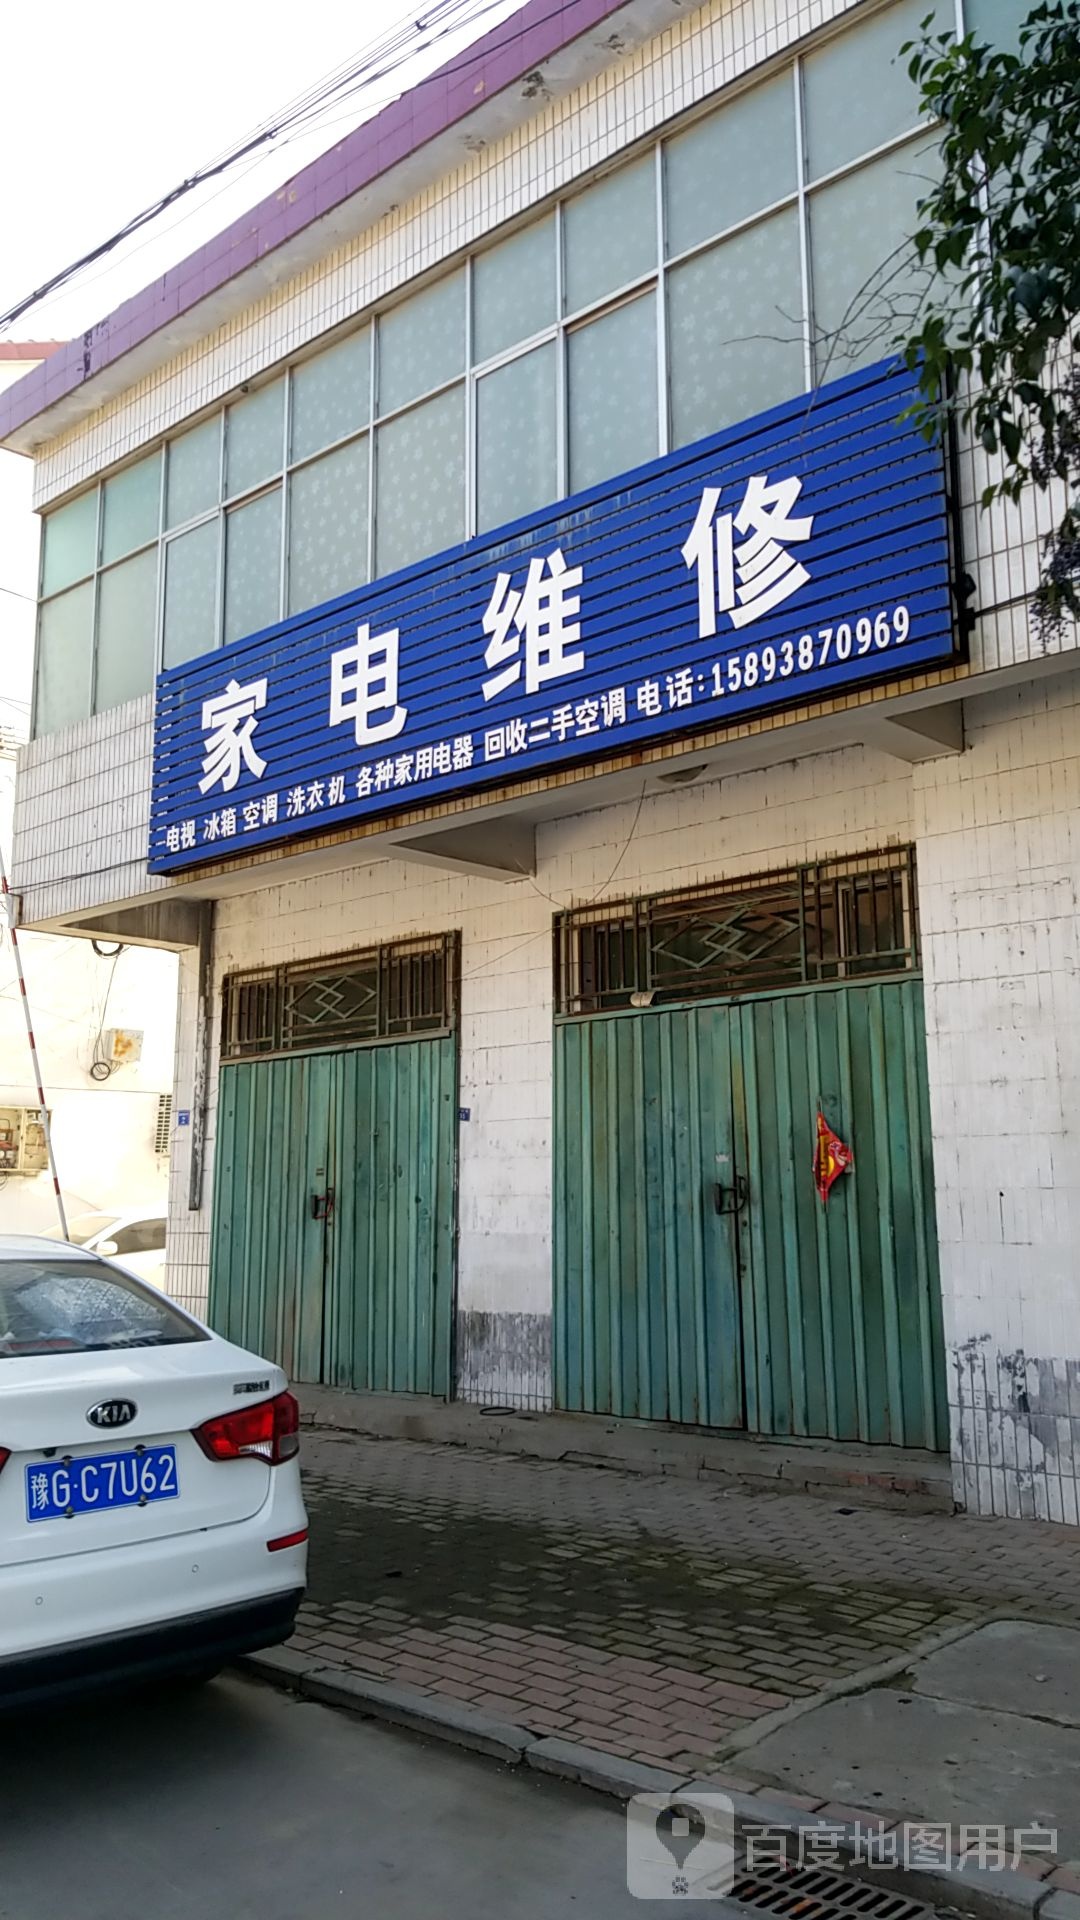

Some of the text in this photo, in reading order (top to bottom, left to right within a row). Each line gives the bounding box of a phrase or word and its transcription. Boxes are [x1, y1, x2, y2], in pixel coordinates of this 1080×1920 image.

[198, 475, 814, 801] 家电维修
[166, 819, 196, 852] 电视
[203, 807, 237, 841] 冰箱
[242, 793, 278, 832] 空调
[286, 775, 346, 818] 洗衣机
[355, 734, 474, 798] 各种家用电器
[484, 686, 626, 762] 回收二手空调
[96, 1404, 132, 1425] KIA
